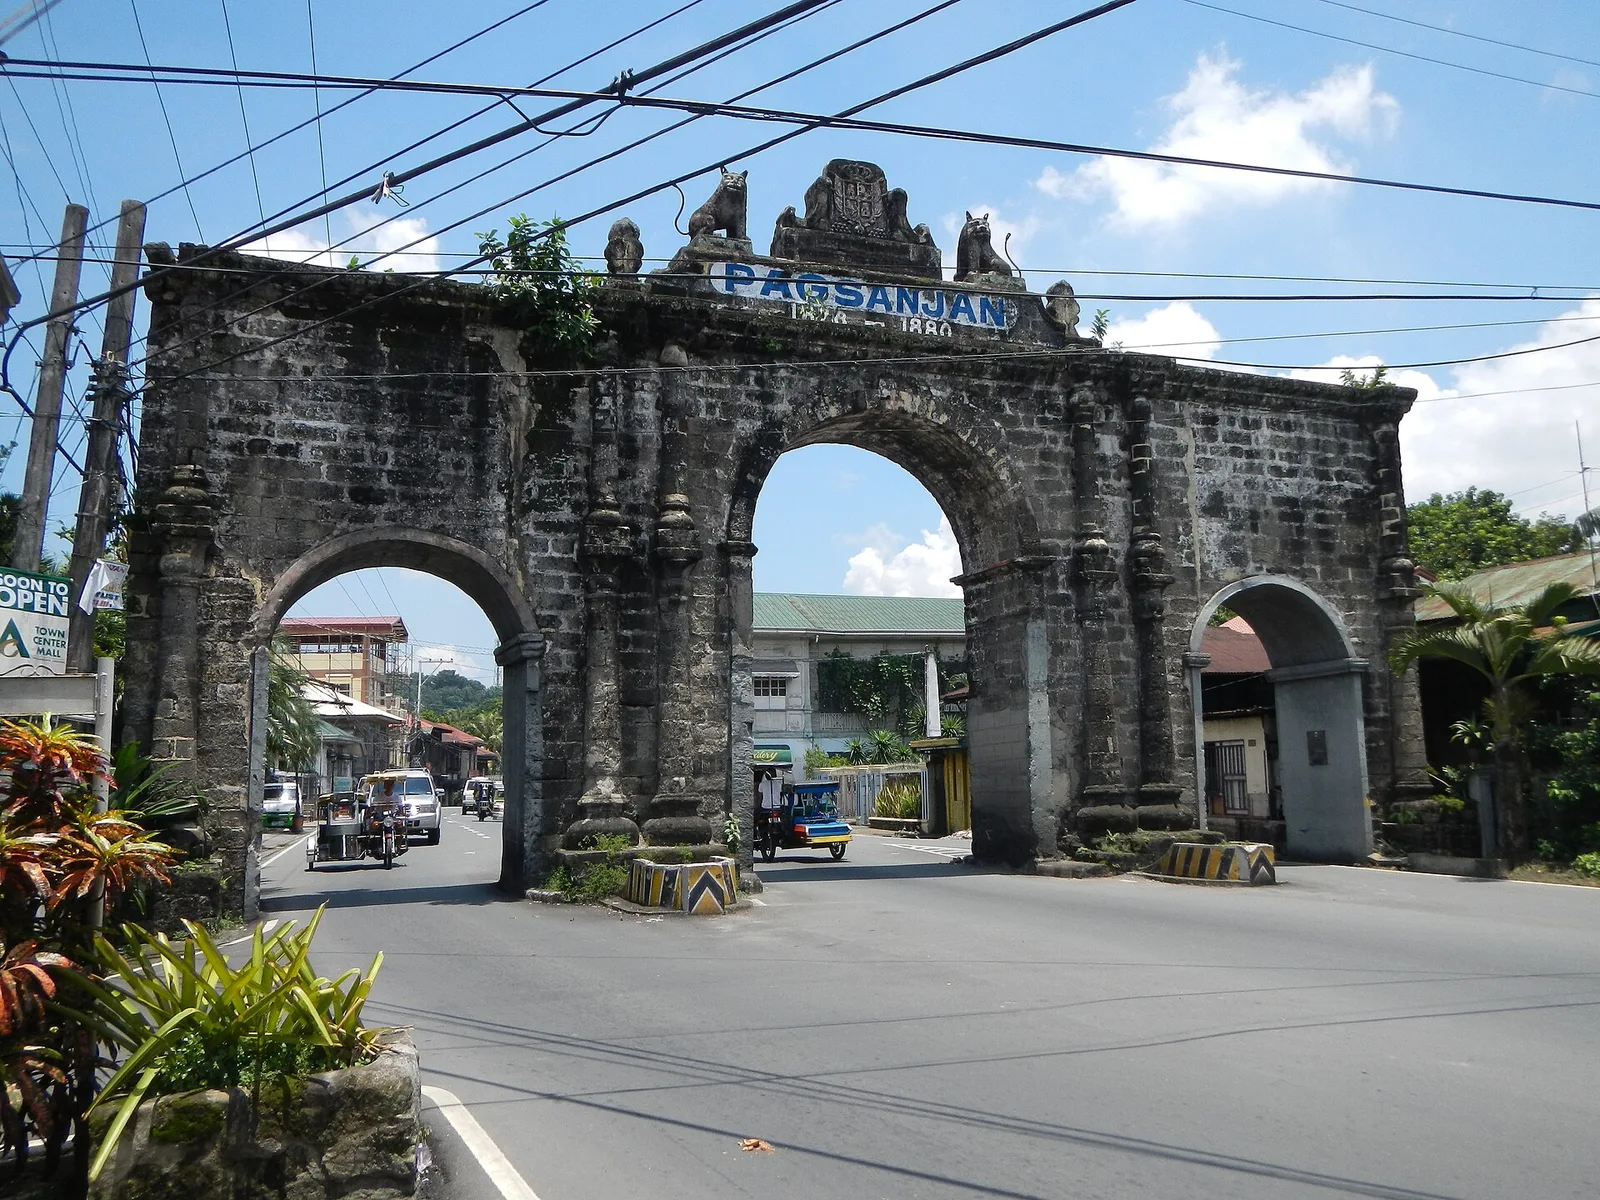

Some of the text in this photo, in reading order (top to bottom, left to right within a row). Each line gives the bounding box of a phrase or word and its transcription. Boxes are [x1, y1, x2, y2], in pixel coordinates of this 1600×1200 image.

[724, 262, 1005, 326] PAGSANJAN
[900, 317, 952, 338] 1880
[48, 581, 69, 596] TO
[0, 586, 69, 616] OPEN
[35, 626, 65, 638] TOWN
[33, 636, 67, 649] CENTER
[36, 647, 61, 658] MALL
